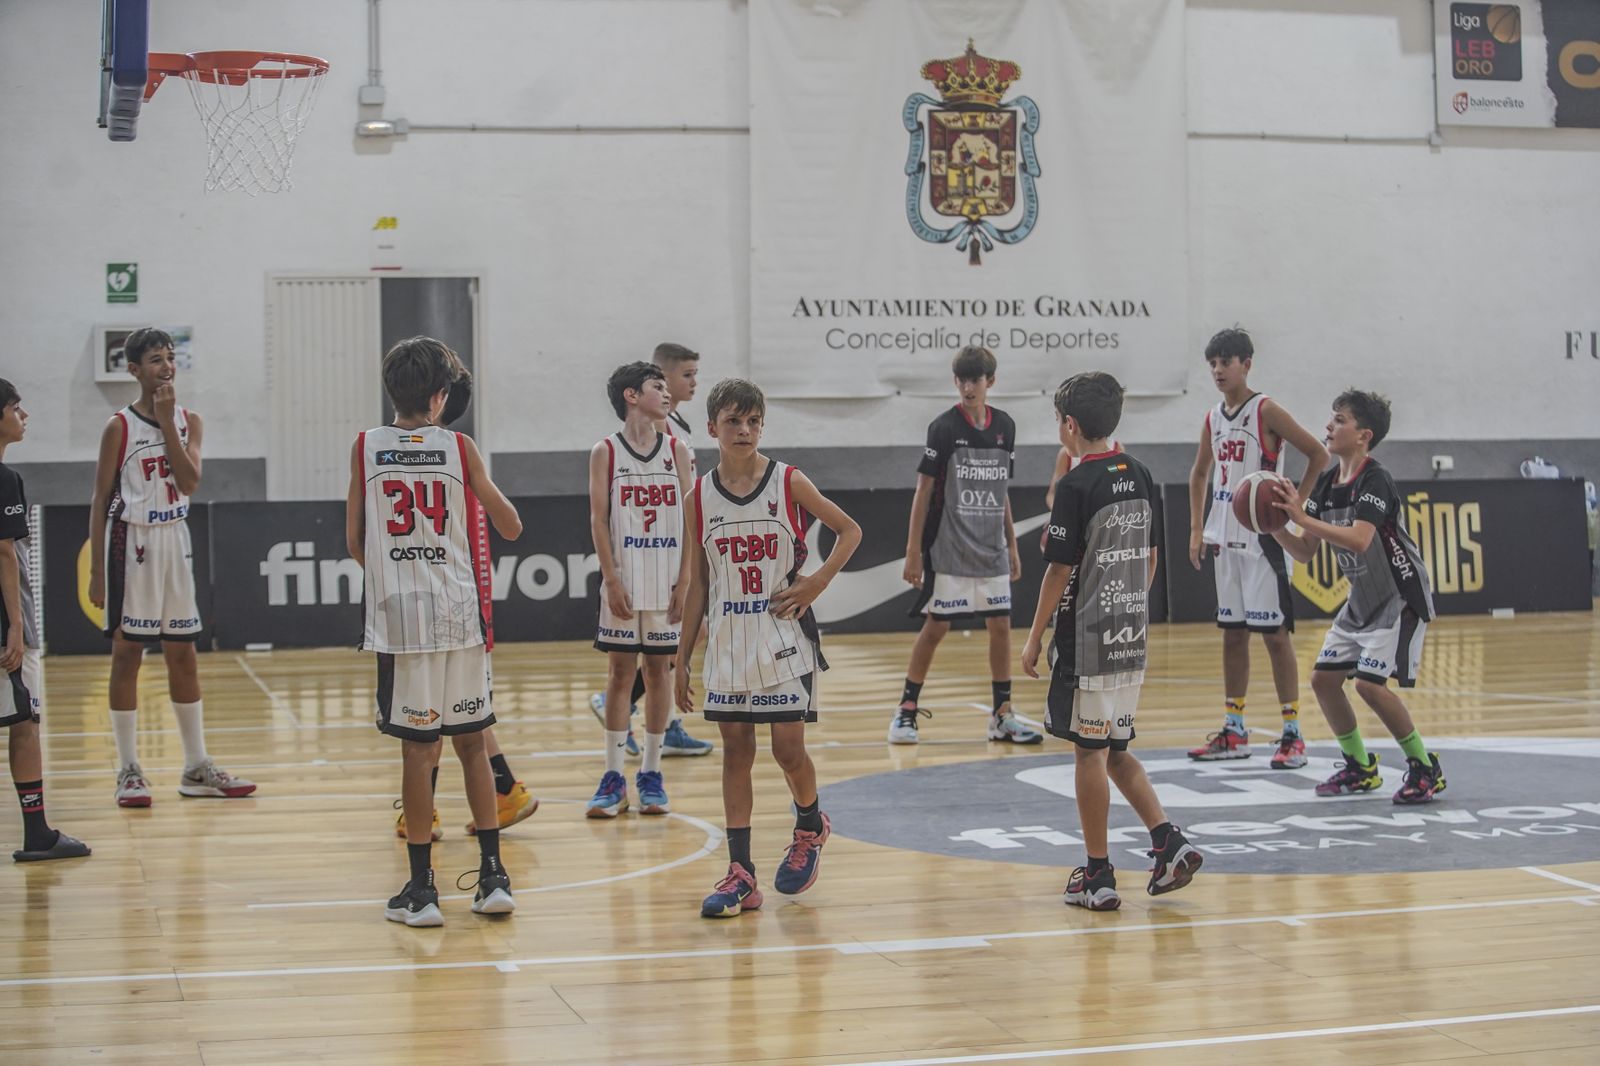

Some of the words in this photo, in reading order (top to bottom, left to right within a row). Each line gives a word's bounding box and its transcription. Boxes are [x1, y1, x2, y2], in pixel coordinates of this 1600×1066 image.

[1453, 12, 1480, 30] Liga
[1455, 39, 1496, 58] LEB
[1455, 60, 1494, 75] ORO
[1470, 96, 1525, 109] baloncesto
[792, 295, 987, 318] AYUNTAMIENTO
[995, 299, 1025, 317] DE
[1034, 294, 1151, 318] GRANADA
[825, 326, 961, 354] Concejalía
[969, 328, 1001, 349] de
[1010, 327, 1120, 353] Deportes
[395, 452, 442, 464] CaixaBank
[141, 455, 170, 482] FC
[1111, 476, 1136, 495] vive
[620, 484, 677, 507] FCBG
[960, 489, 999, 507] OYA
[382, 479, 449, 537] 34
[643, 509, 657, 533] 7
[623, 535, 678, 549] PULEVA
[715, 532, 778, 564] FCBG
[389, 546, 447, 562] CASTOR
[738, 565, 763, 595] 18
[933, 598, 969, 609] PULEVA
[1112, 588, 1147, 604] Greenin
[722, 599, 770, 617] PULEV
[1125, 602, 1145, 614] Grou
